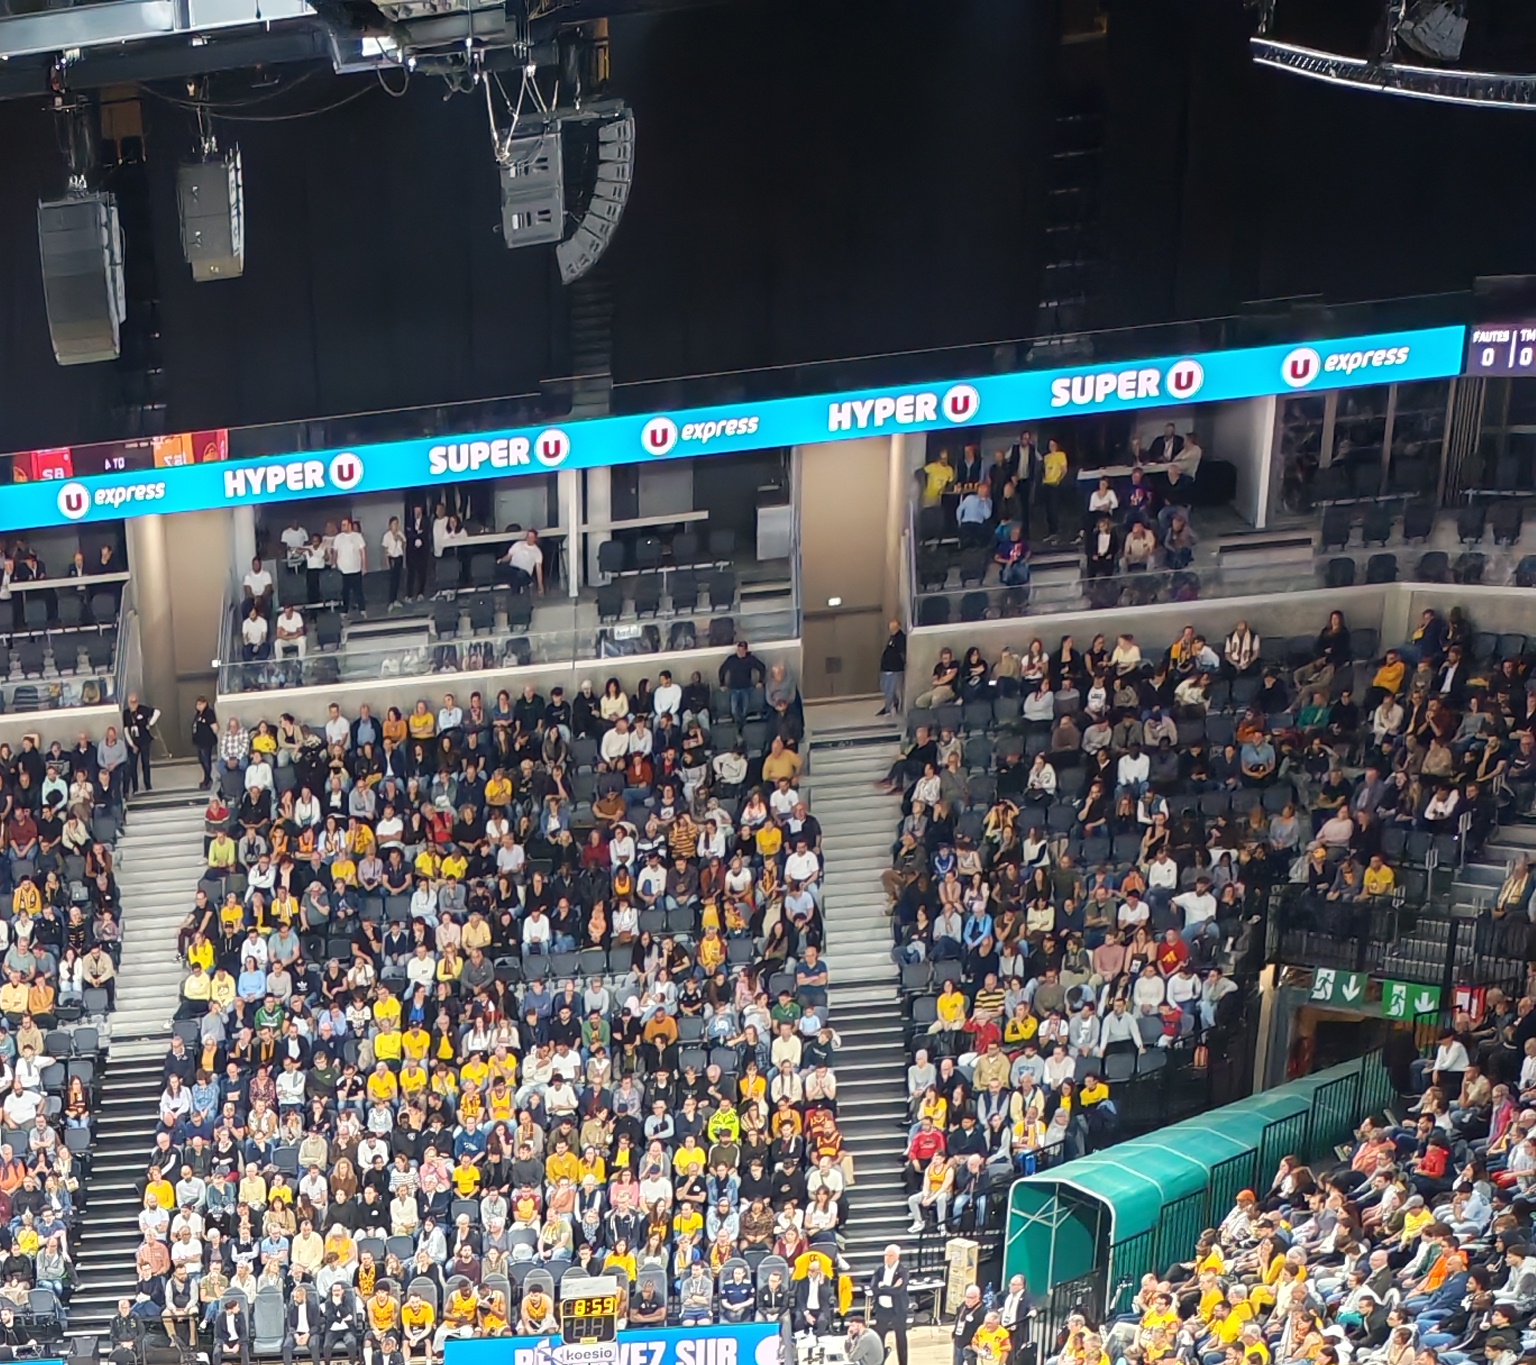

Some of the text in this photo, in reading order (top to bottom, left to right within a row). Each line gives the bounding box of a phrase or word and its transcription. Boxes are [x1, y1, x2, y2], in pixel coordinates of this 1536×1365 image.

[1291, 345, 1410, 379] U express
[1051, 366, 1194, 407] SUPER U
[828, 391, 970, 432] HYPER U
[651, 415, 760, 447] U express
[429, 436, 560, 475] SUPER U
[65, 480, 166, 511] U express
[223, 460, 354, 498] HYPER U
[574, 1296, 614, 1316] 8:59
[566, 1346, 613, 1360] koesio
